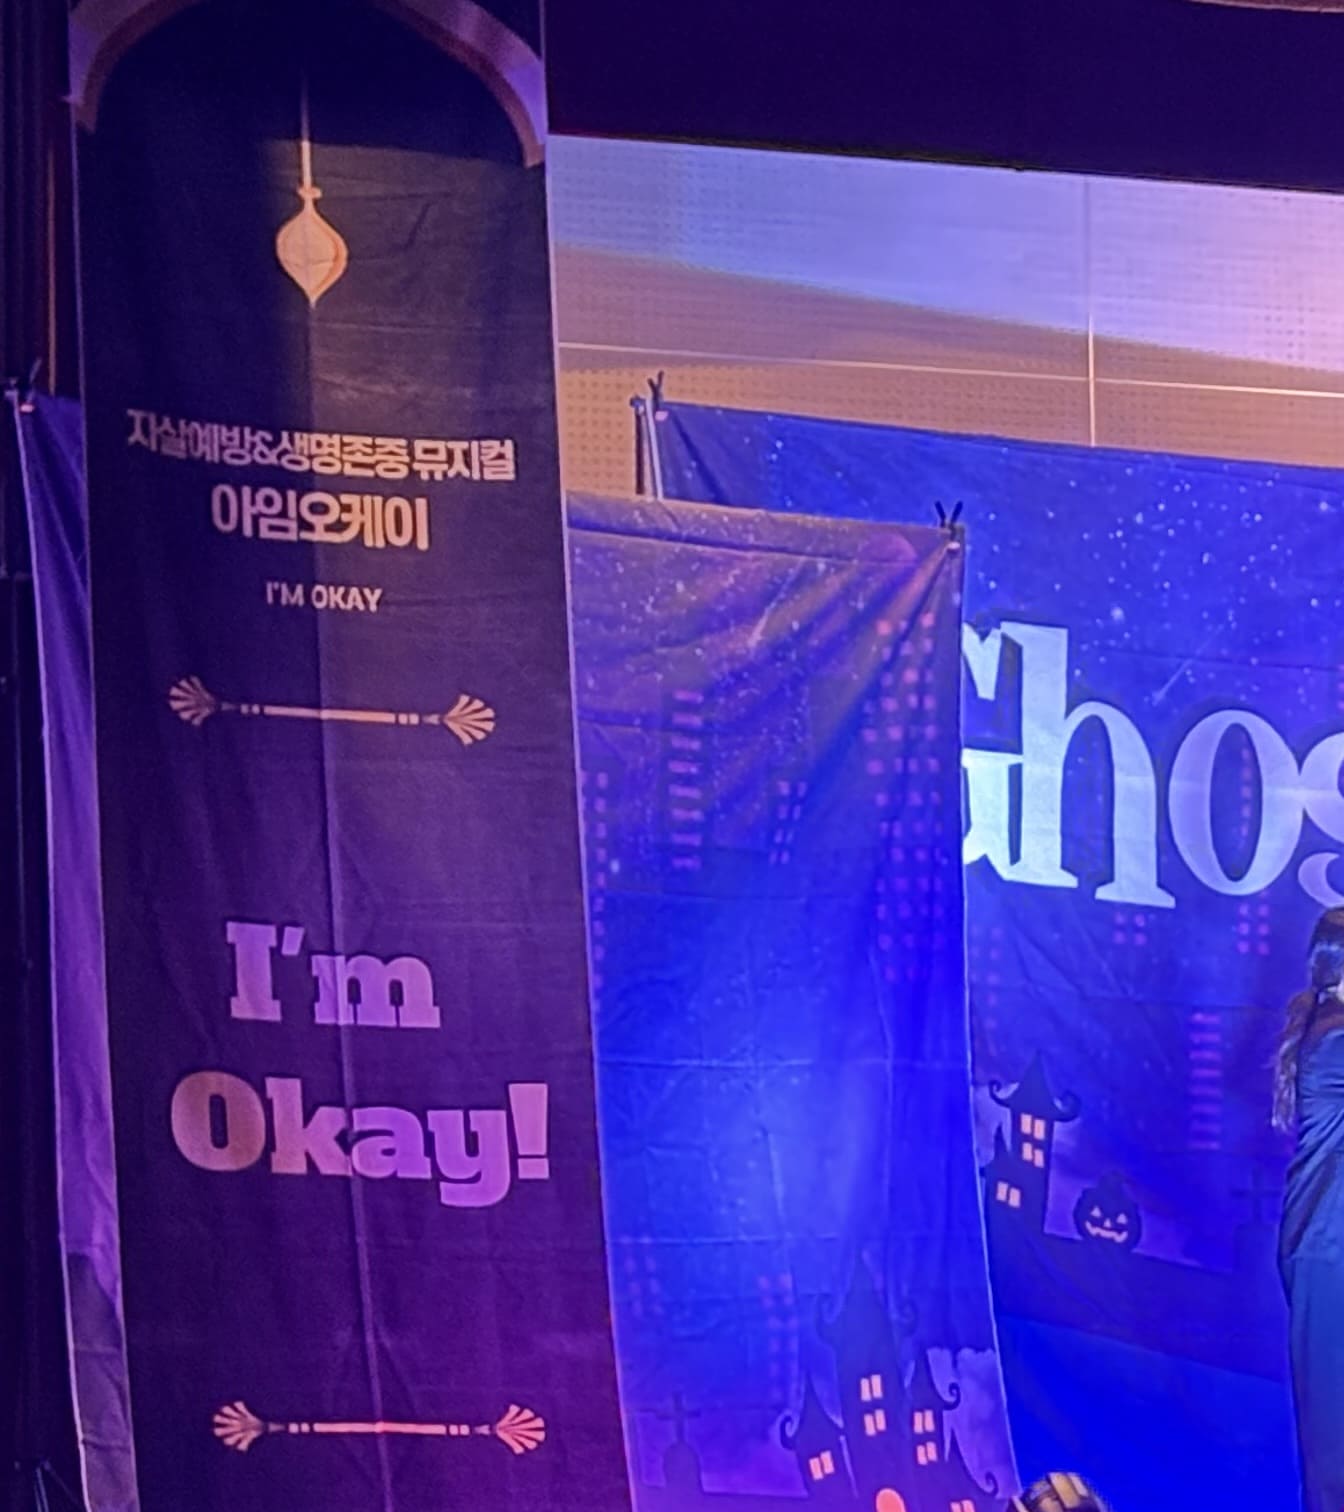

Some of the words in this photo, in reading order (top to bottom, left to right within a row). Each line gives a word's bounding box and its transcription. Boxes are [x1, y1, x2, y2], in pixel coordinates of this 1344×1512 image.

[126, 408, 411, 480] 자살예방&생명존중
[412, 439, 516, 481] 뮤지컬
[210, 483, 431, 551] 아임오케이
[266, 581, 304, 607] I'M
[311, 585, 383, 613] OKAY
[225, 920, 442, 1029] I'm
[170, 1070, 551, 1209] Okay!
